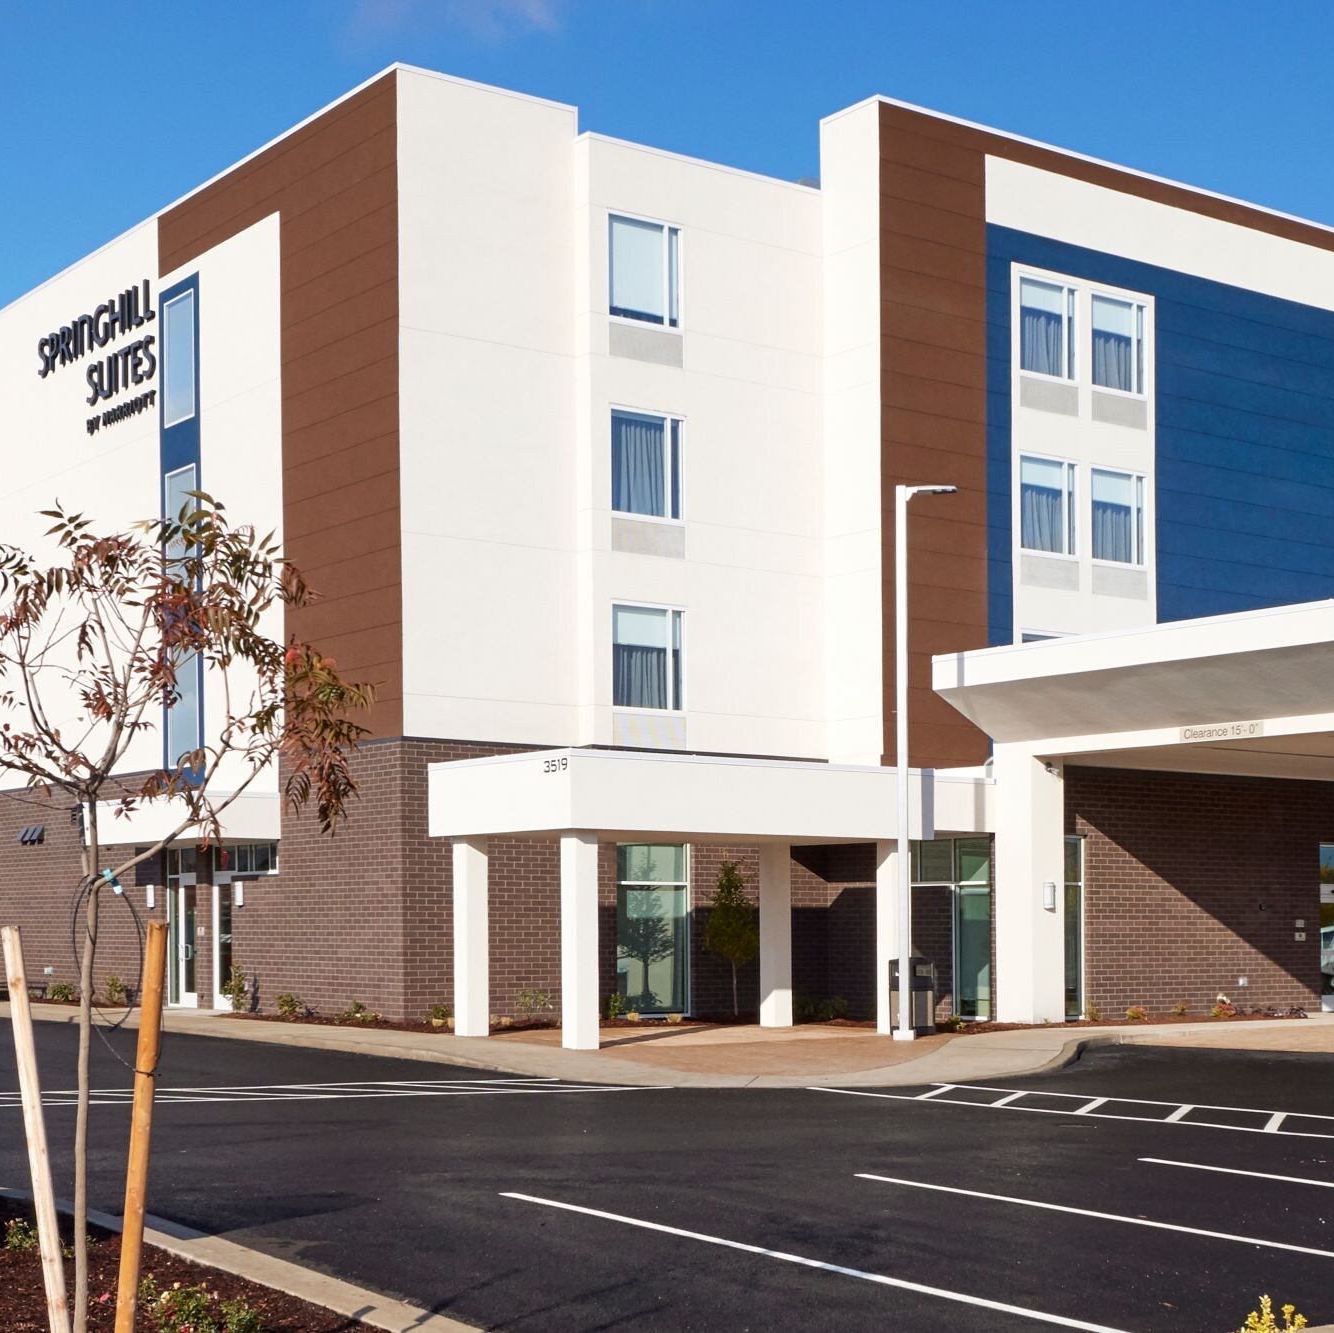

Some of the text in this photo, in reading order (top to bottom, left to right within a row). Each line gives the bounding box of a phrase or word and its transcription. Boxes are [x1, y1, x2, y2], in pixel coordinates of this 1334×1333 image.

[38, 279, 156, 379] SPRINGHILL
[86, 335, 156, 406] SUITES
[86, 390, 156, 436] BY MARRIOTT
[1184, 727, 1228, 740] Clearance
[543, 757, 568, 773] 3519
